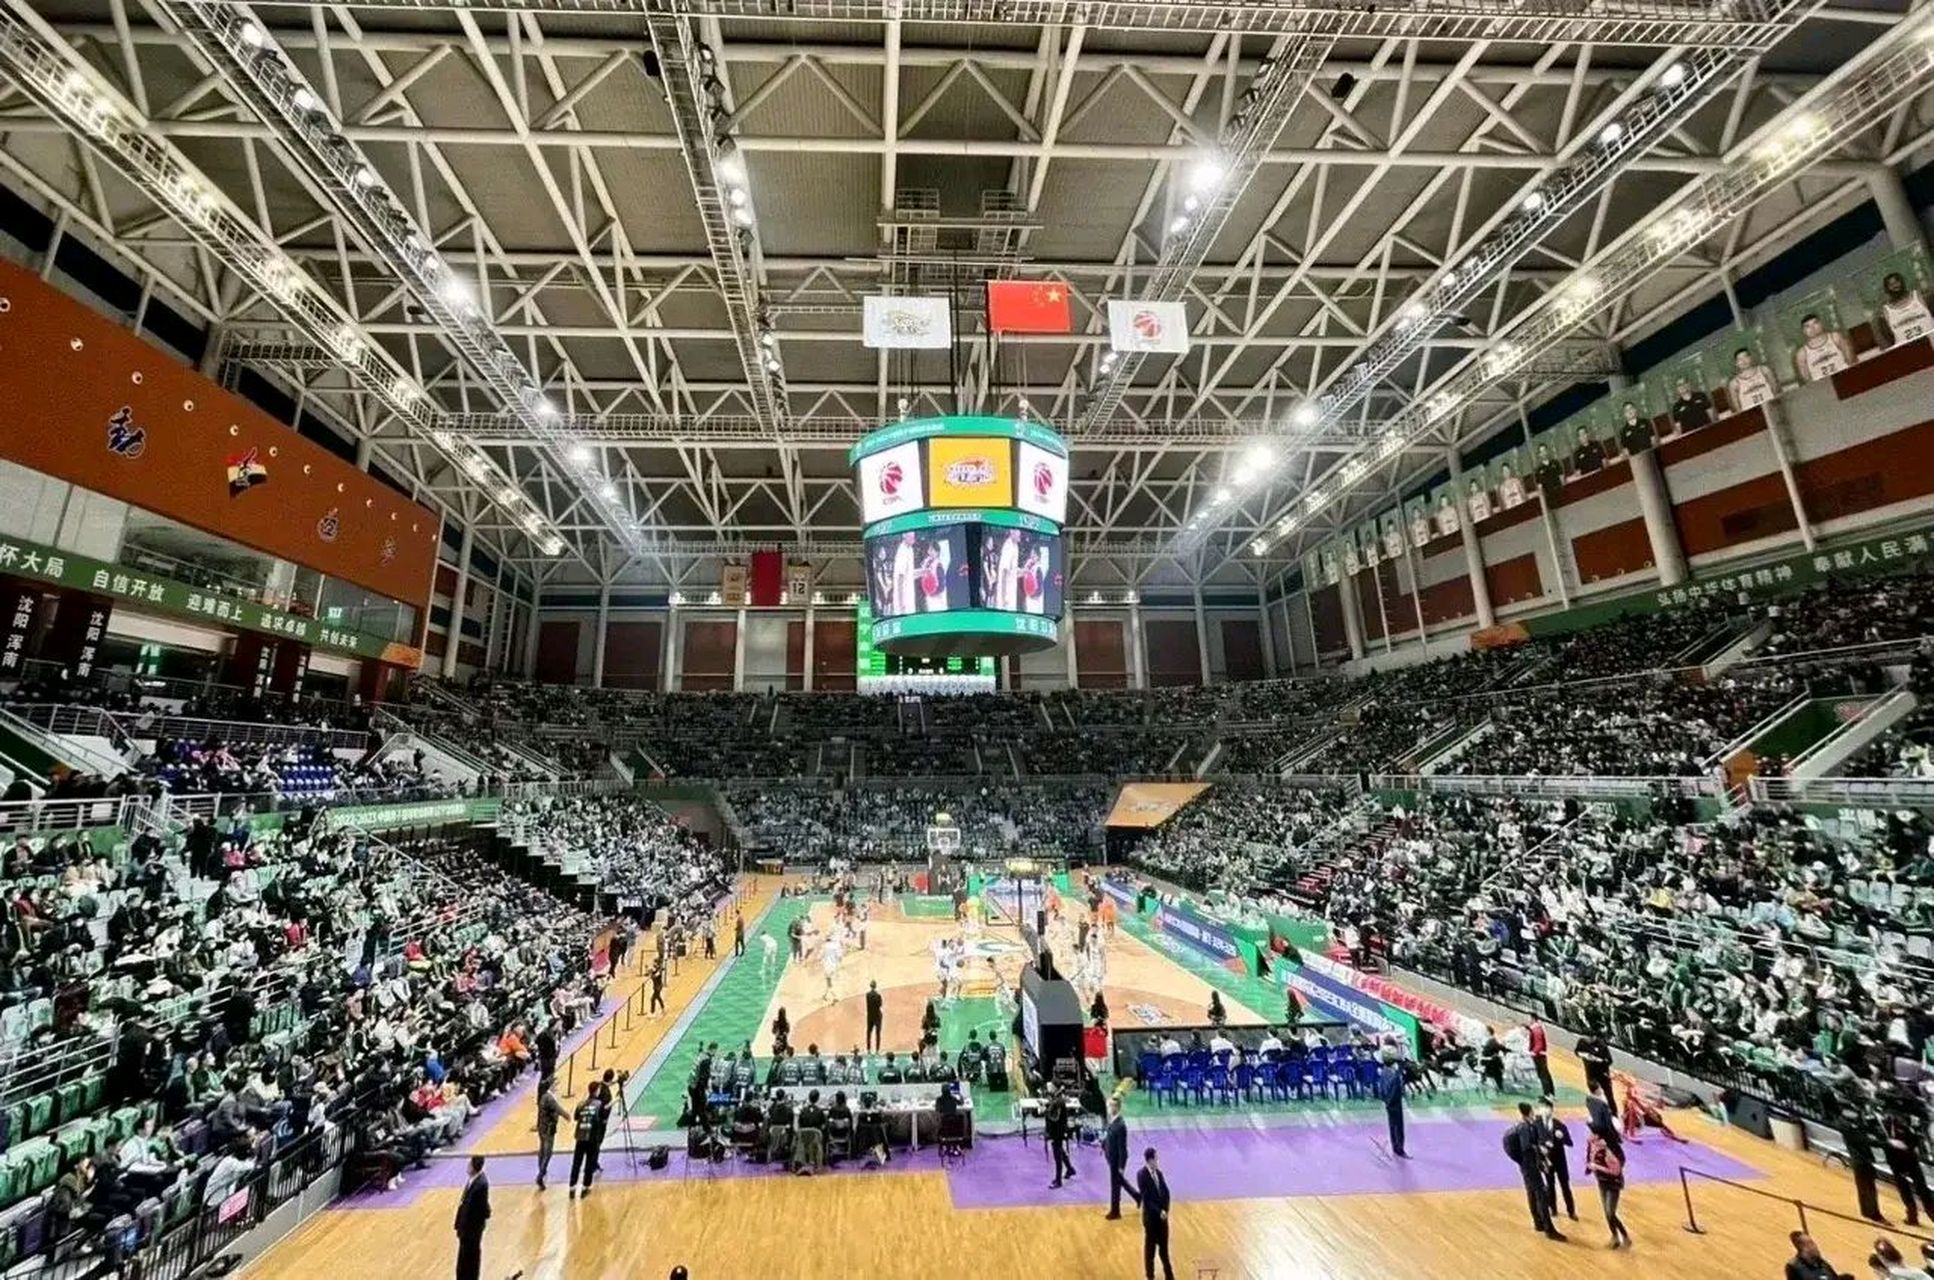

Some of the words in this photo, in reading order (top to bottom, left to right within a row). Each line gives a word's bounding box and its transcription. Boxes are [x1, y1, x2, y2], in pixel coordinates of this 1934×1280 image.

[93, 569, 166, 602] 自信开放
[1657, 565, 1793, 607] 弘扬中华体育精神
[1812, 532, 1934, 573] 奉献人民满
[12, 595, 34, 629] 沈阳
[86, 611, 104, 641] 沈阳
